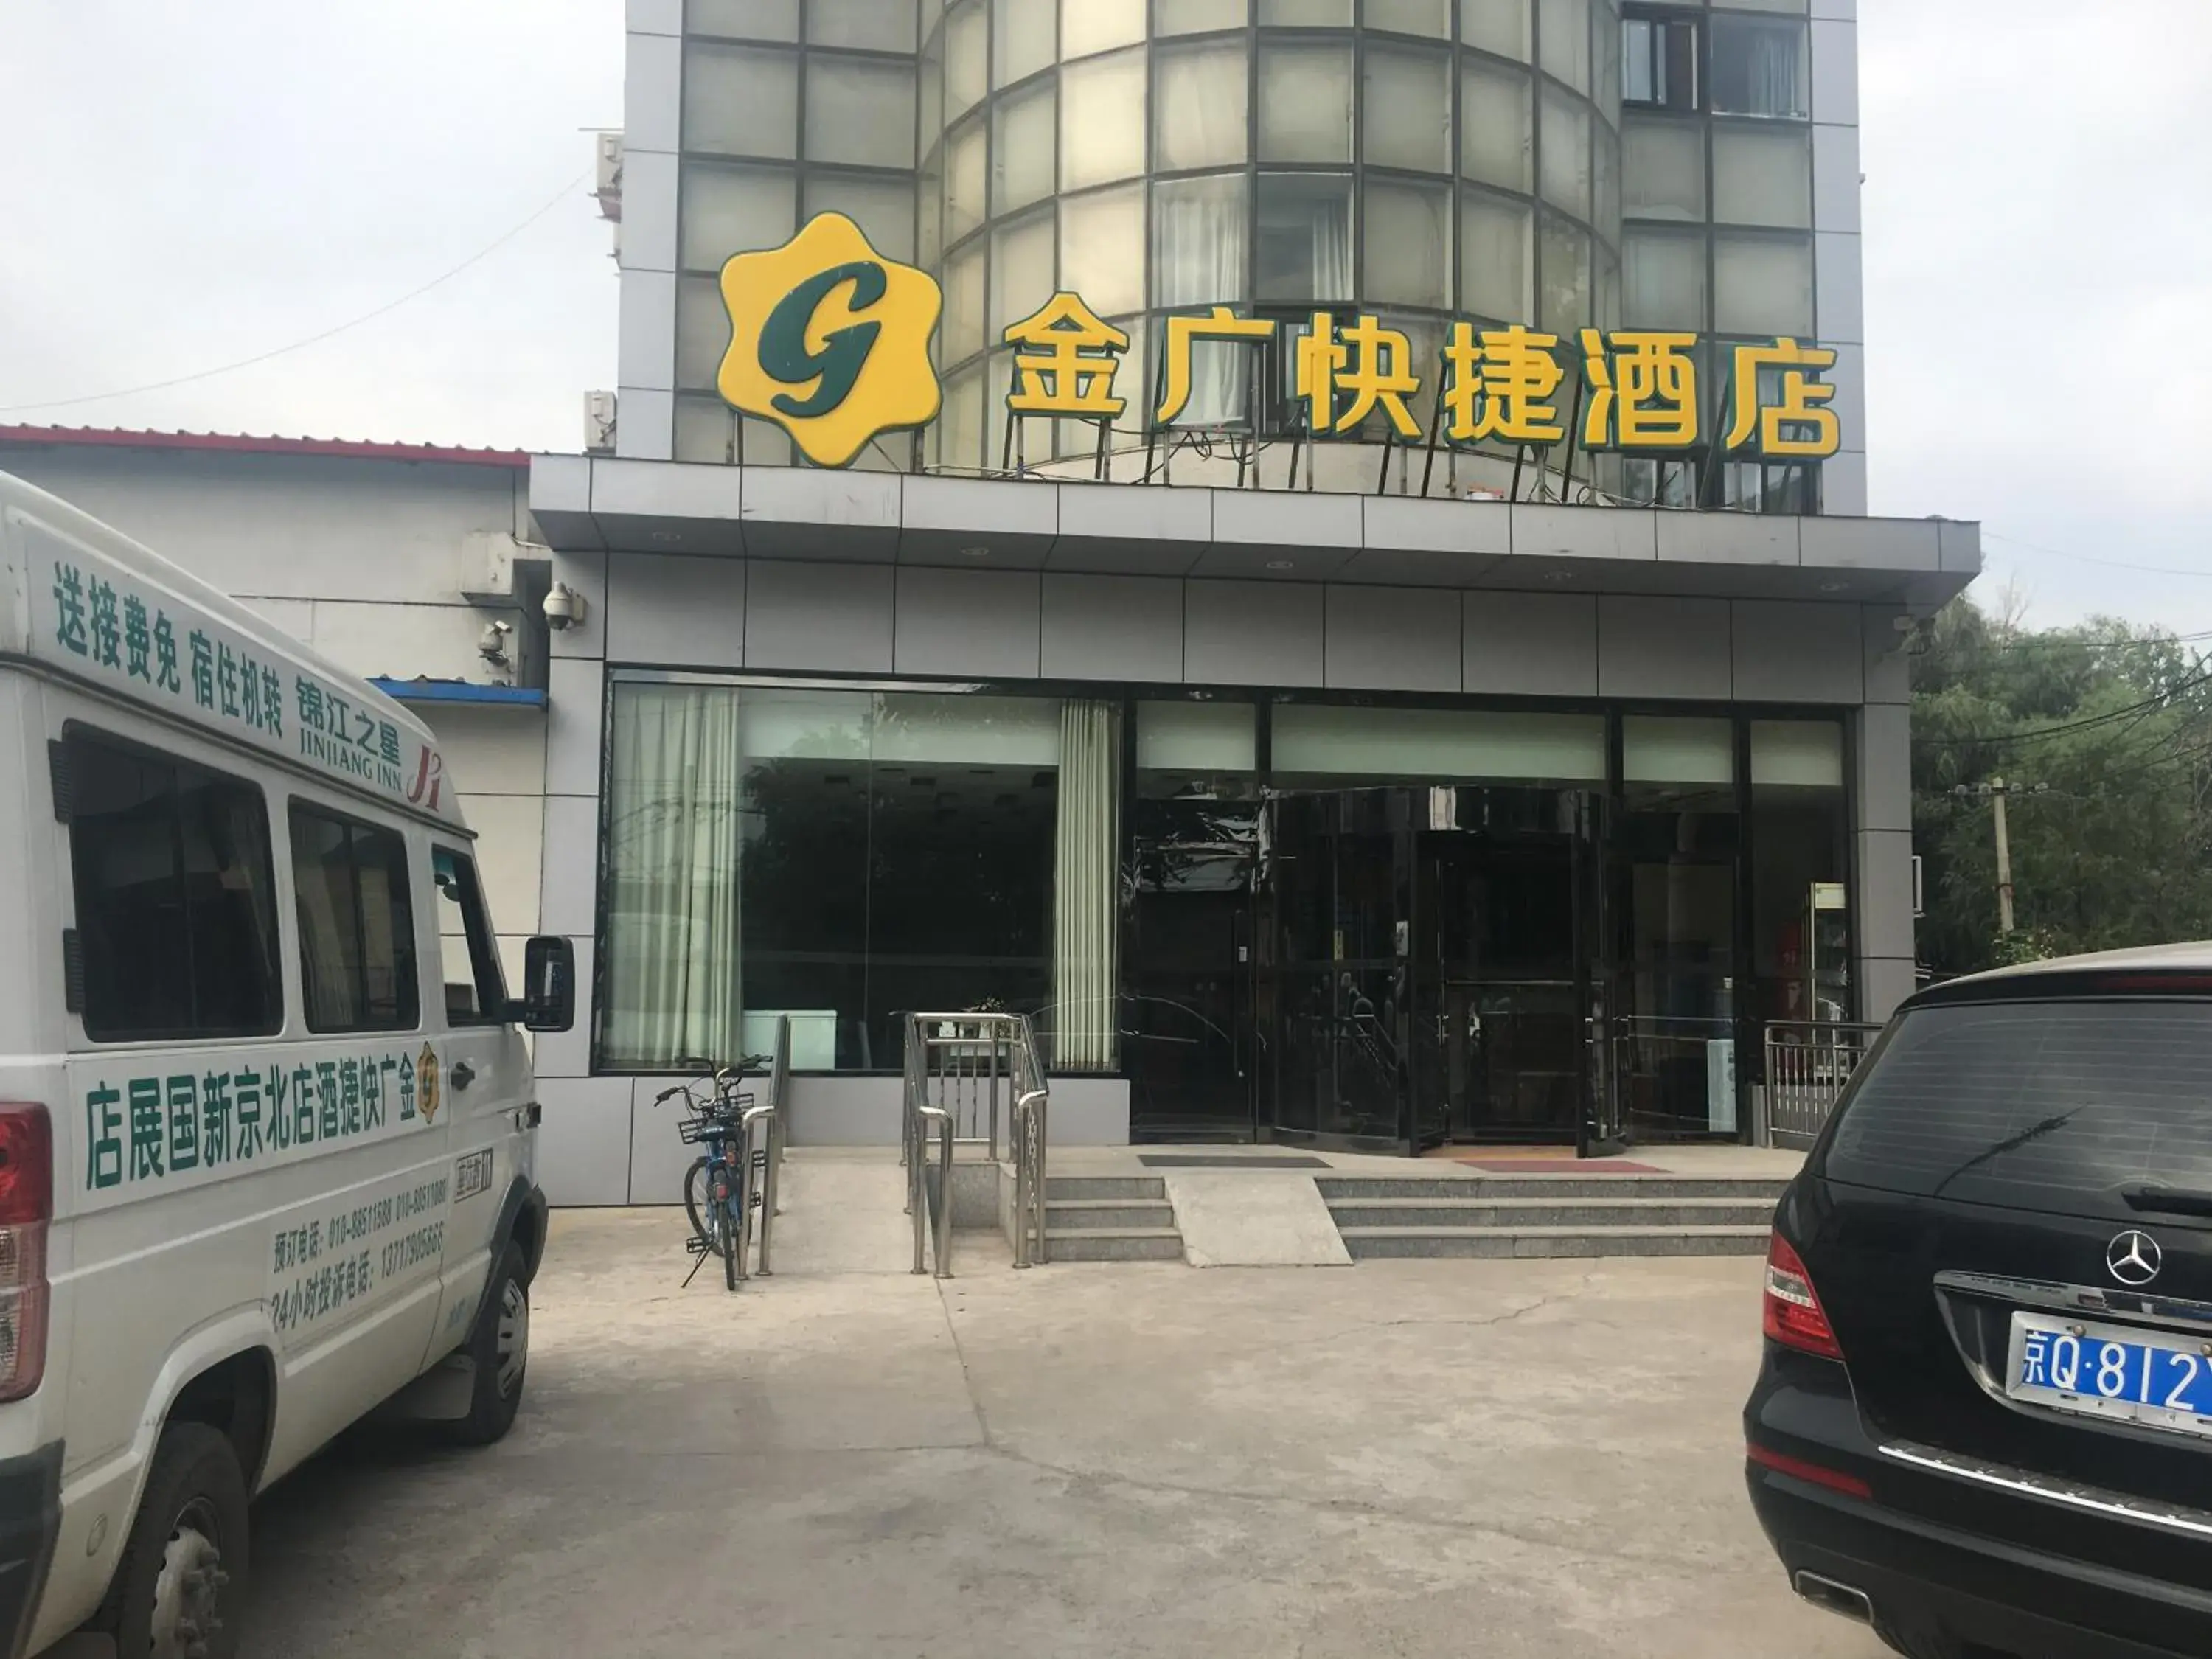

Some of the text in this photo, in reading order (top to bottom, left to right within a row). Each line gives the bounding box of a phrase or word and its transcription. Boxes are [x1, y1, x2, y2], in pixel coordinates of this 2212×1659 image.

[1003, 291, 1840, 459] 金广快捷酒店
[296, 673, 401, 767] 锦江之星
[300, 728, 403, 793] JINJIANG INN
[2023, 1330, 2212, 1411] 京Q·812
